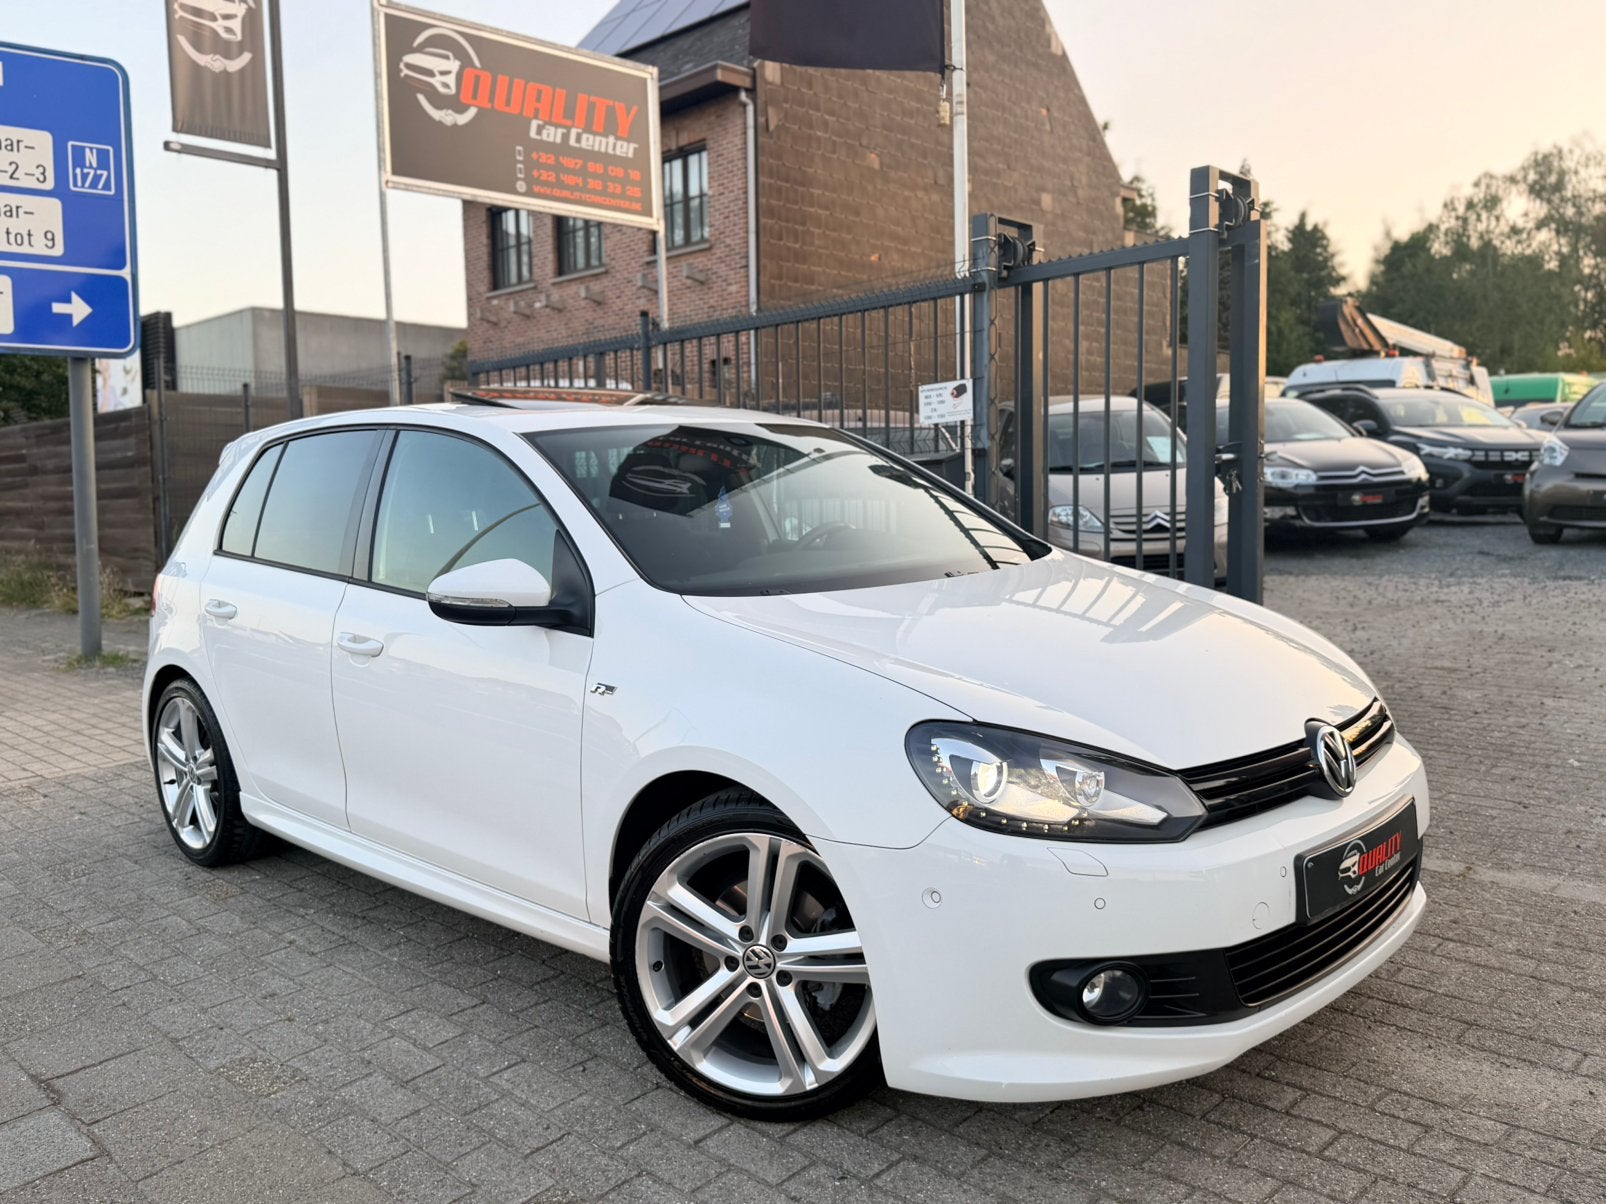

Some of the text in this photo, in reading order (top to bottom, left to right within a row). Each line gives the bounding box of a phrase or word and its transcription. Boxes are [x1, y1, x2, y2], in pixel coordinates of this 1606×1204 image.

[459, 67, 639, 138] QUALITY
[0, 137, 36, 153] ar-
[529, 119, 639, 159] Car Center
[85, 147, 98, 168] N
[75, 167, 108, 190] 177
[0, 203, 35, 219] ar-
[5, 227, 56, 250] tot 9
[1359, 832, 1403, 876] QUALITY
